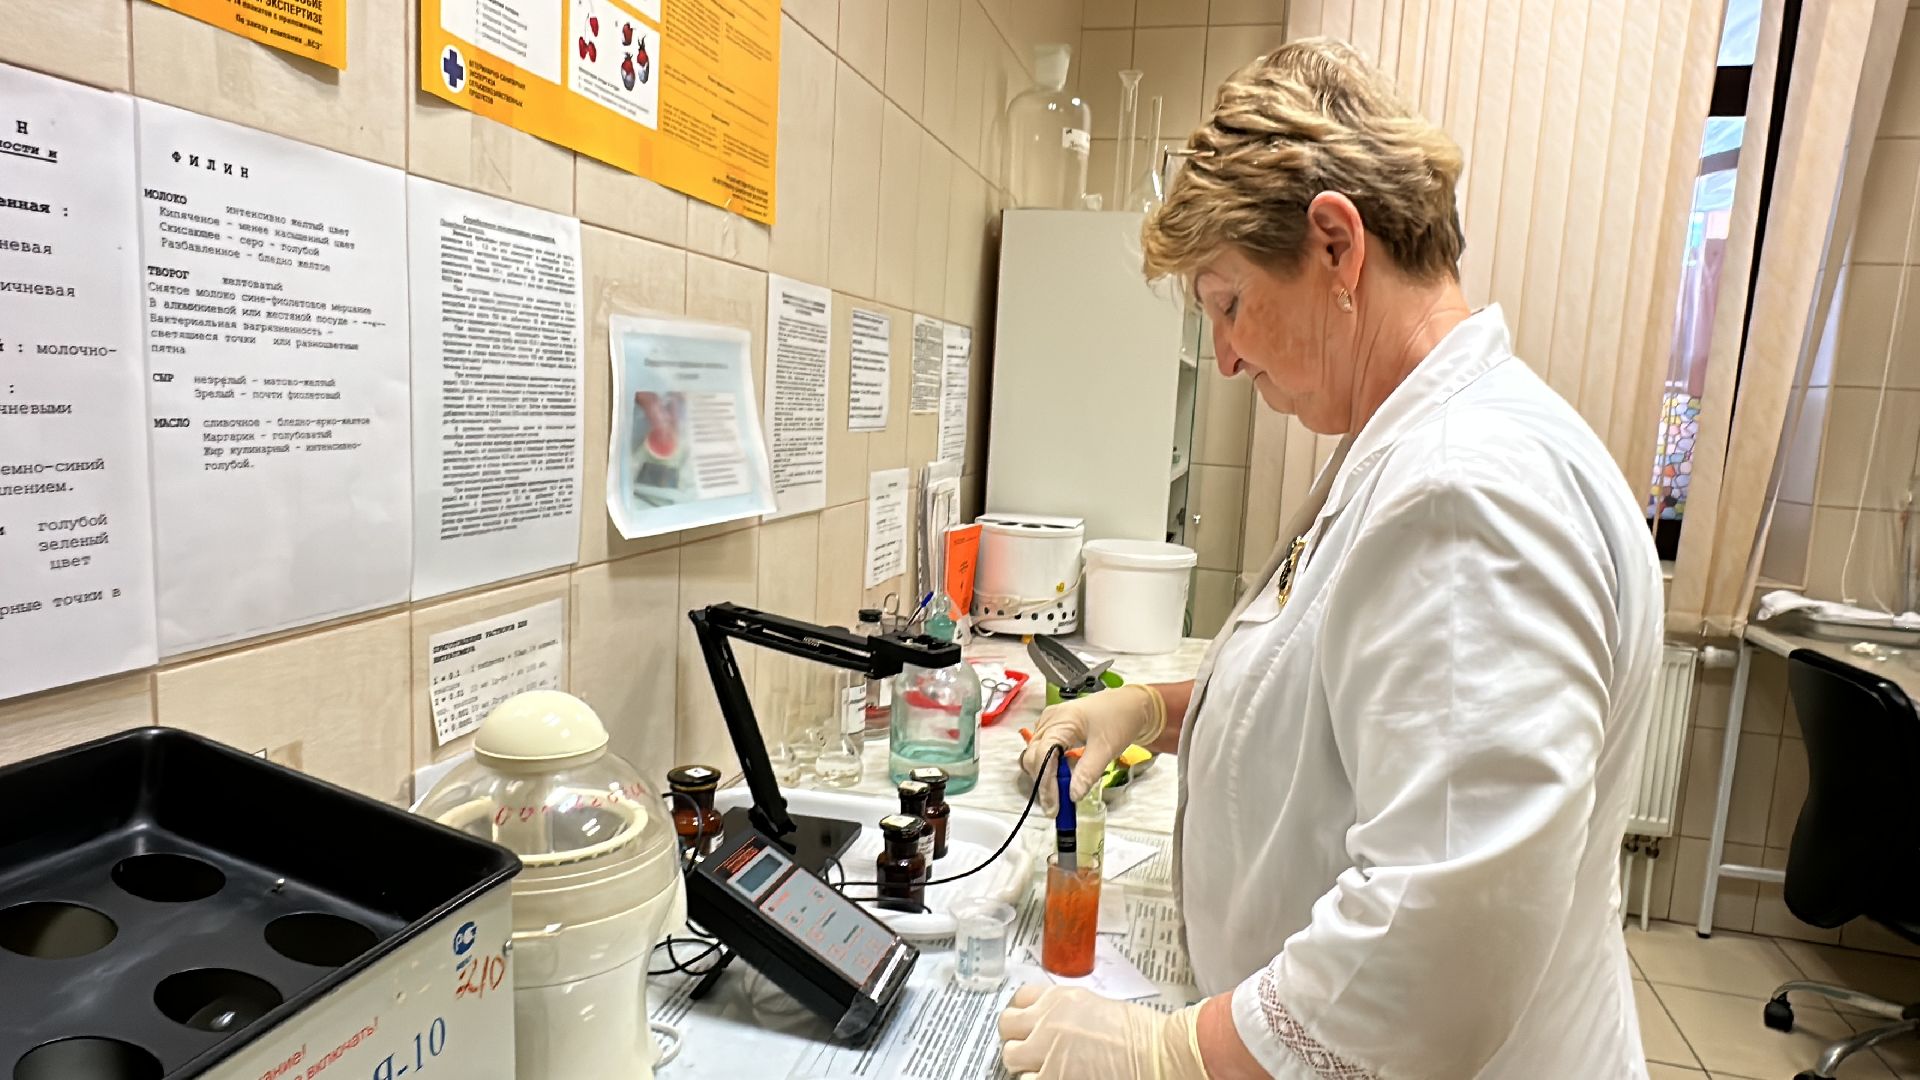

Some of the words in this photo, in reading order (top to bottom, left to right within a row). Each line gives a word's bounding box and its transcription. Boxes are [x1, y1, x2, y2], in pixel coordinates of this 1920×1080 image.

[143, 188, 188, 205] МОЛОКО
[159, 206, 220, 226] Кипяченое
[238, 222, 269, 236] менее
[334, 240, 355, 250] цвет
[291, 218, 325, 232] желтый
[328, 226, 350, 237] цвет
[239, 236, 265, 249] серо
[281, 243, 320, 257] голубой
[161, 237, 241, 259] Разбавленное
[258, 252, 293, 267] бледно
[297, 260, 331, 273] желтое
[147, 265, 190, 280] ТВОРОГ
[148, 281, 190, 296] Снятое
[196, 289, 236, 301] молоко
[149, 297, 157, 308] В
[242, 308, 261, 317] или
[149, 313, 237, 329] Бактериальная
[225, 335, 257, 345] точки
[151, 344, 186, 355] пятна
[152, 373, 175, 383] СЫР
[252, 391, 283, 400] почти
[153, 418, 191, 428] МАСЛО
[202, 419, 261, 428] сливочное
[202, 433, 256, 444] Маргарин
[272, 430, 332, 441] голубоватый
[203, 446, 225, 458] Жир
[229, 444, 290, 456] кулинарный
[204, 458, 256, 472] голубой.
[37, 513, 108, 532] голубой
[38, 532, 109, 552] зеленый
[50, 555, 91, 570] цвет
[52, 591, 103, 608] точки
